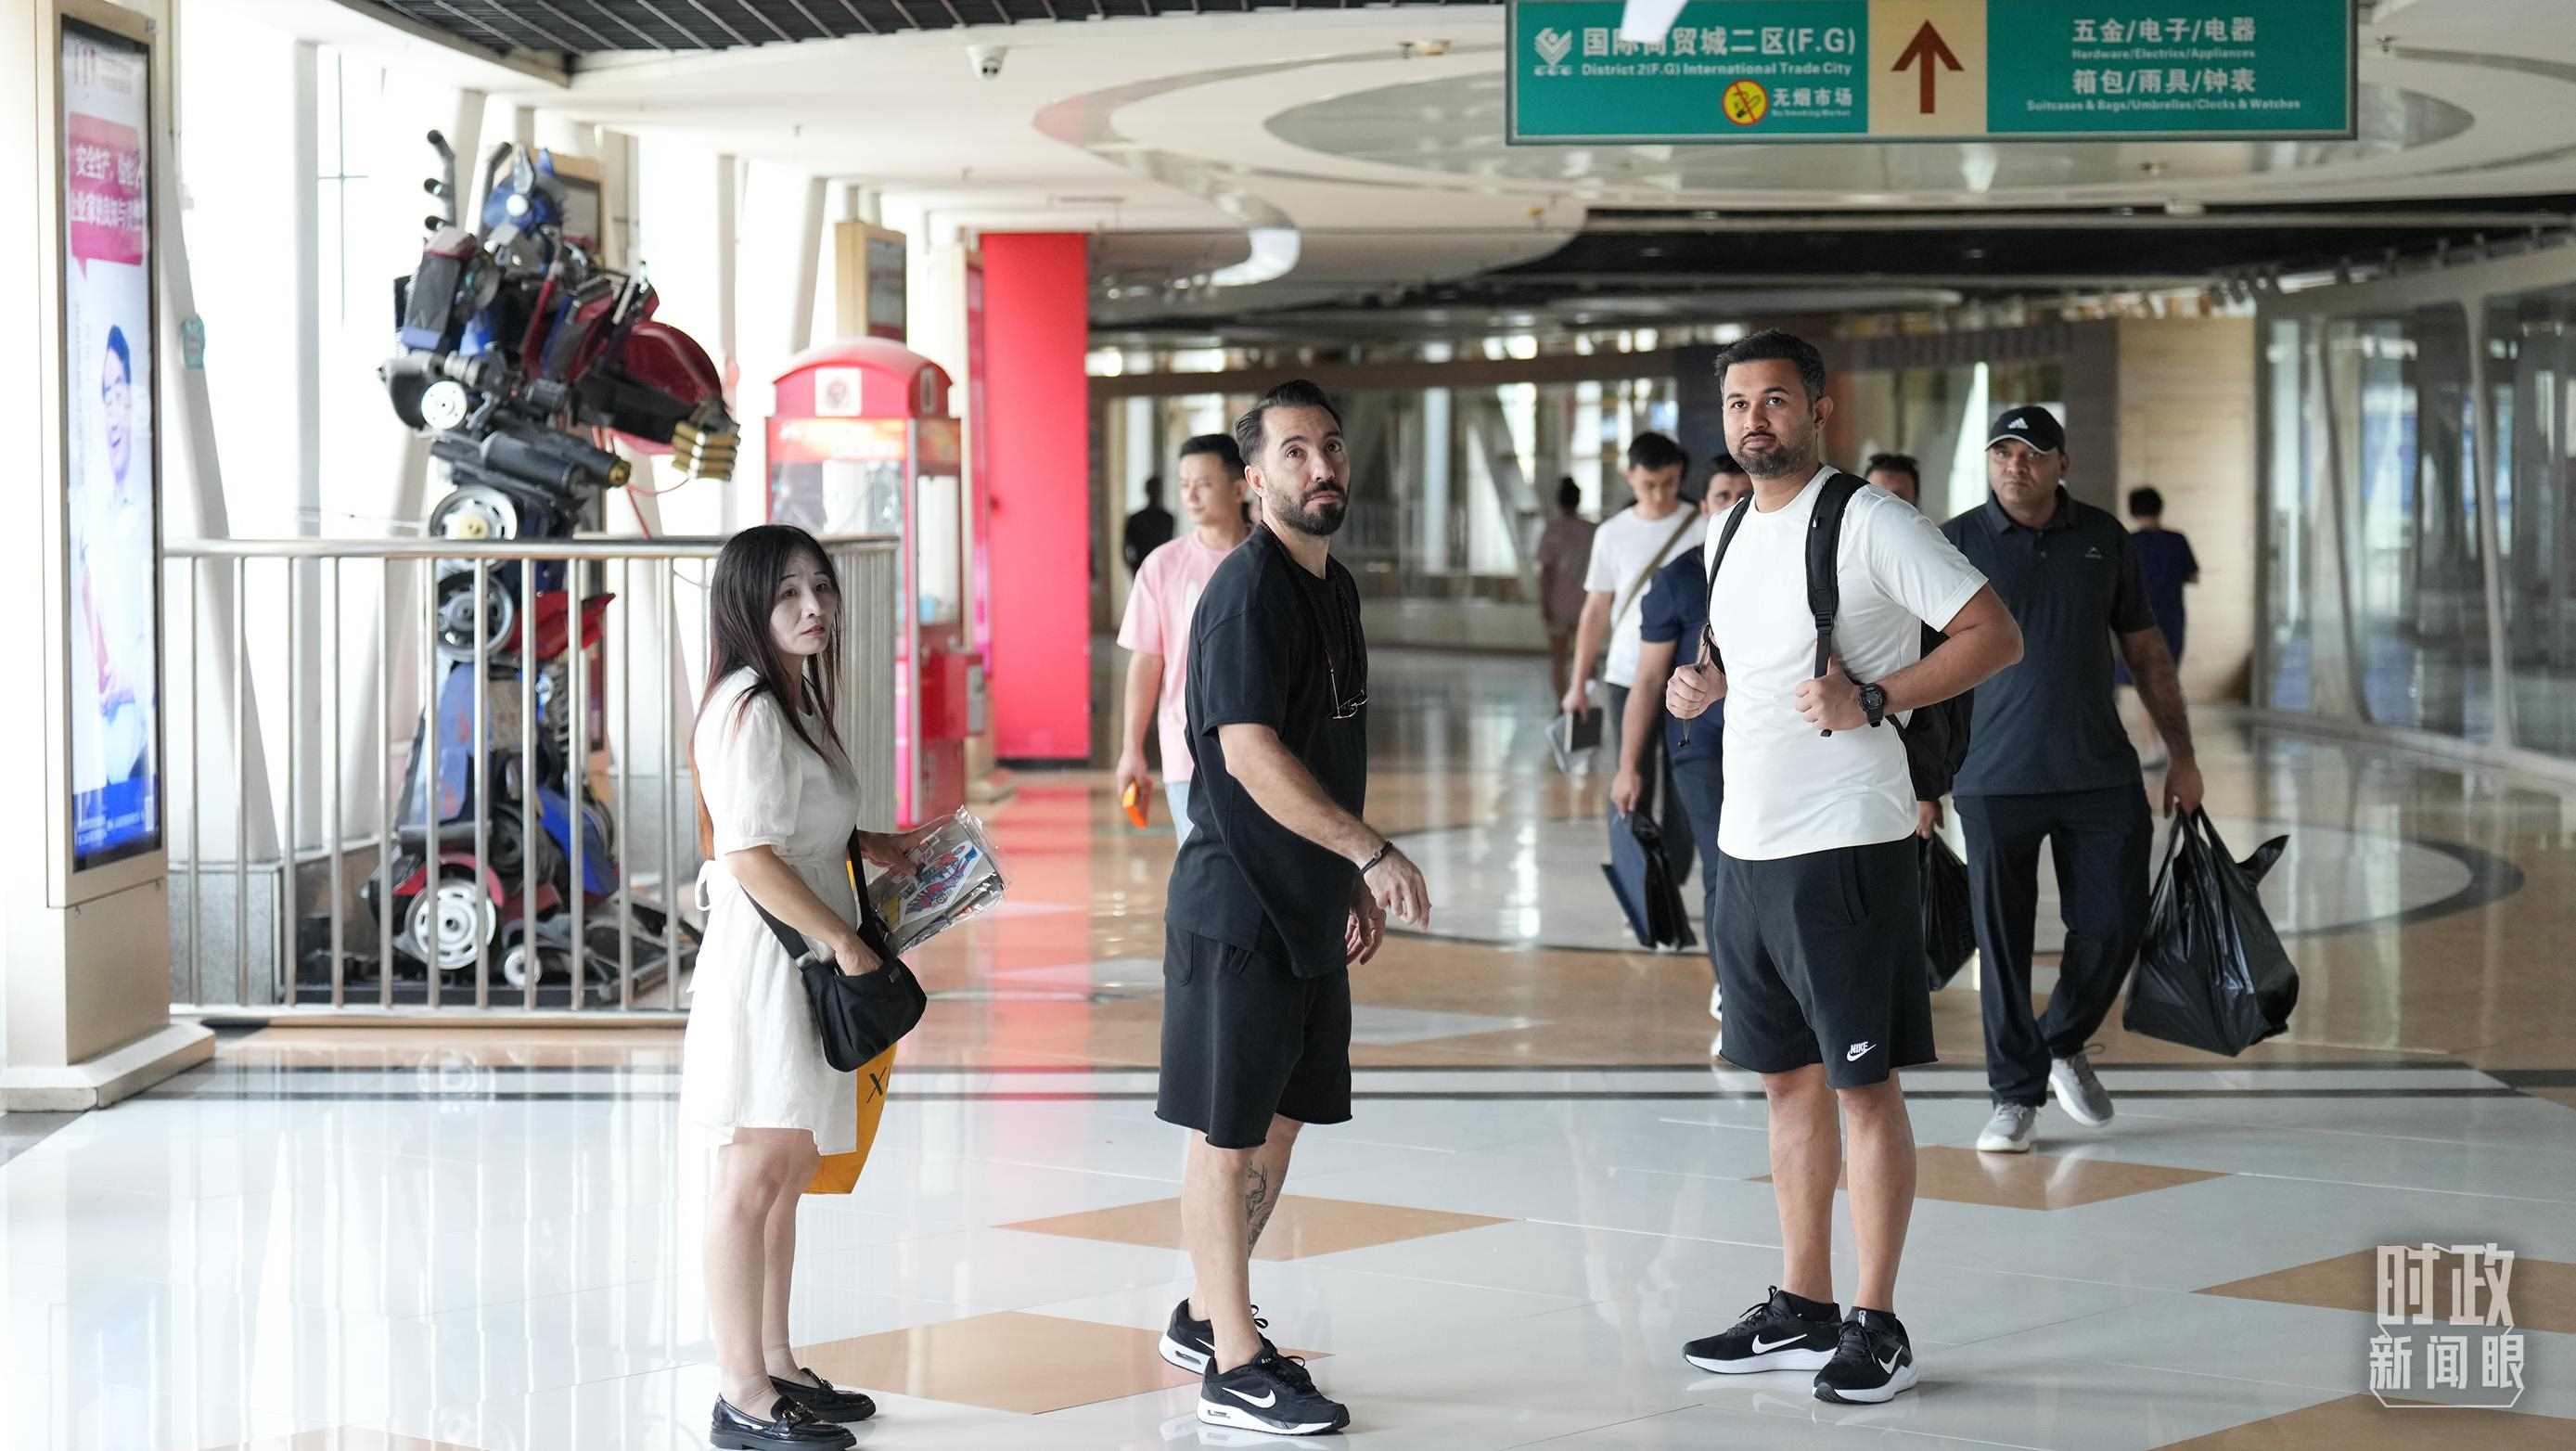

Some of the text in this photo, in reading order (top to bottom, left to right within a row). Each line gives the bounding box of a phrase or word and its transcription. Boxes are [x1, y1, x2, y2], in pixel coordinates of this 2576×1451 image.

[2072, 17, 2256, 43] 五金/电子/电器
[1582, 63, 1634, 75] District
[1683, 62, 1776, 75] International
[1779, 62, 1820, 74] Trade
[1823, 61, 1852, 76] City
[2072, 68, 2256, 94] 箱包/雨具/钟表
[1773, 87, 1852, 107] 无烟市场
[1850, 1041, 1868, 1055] NIKE
